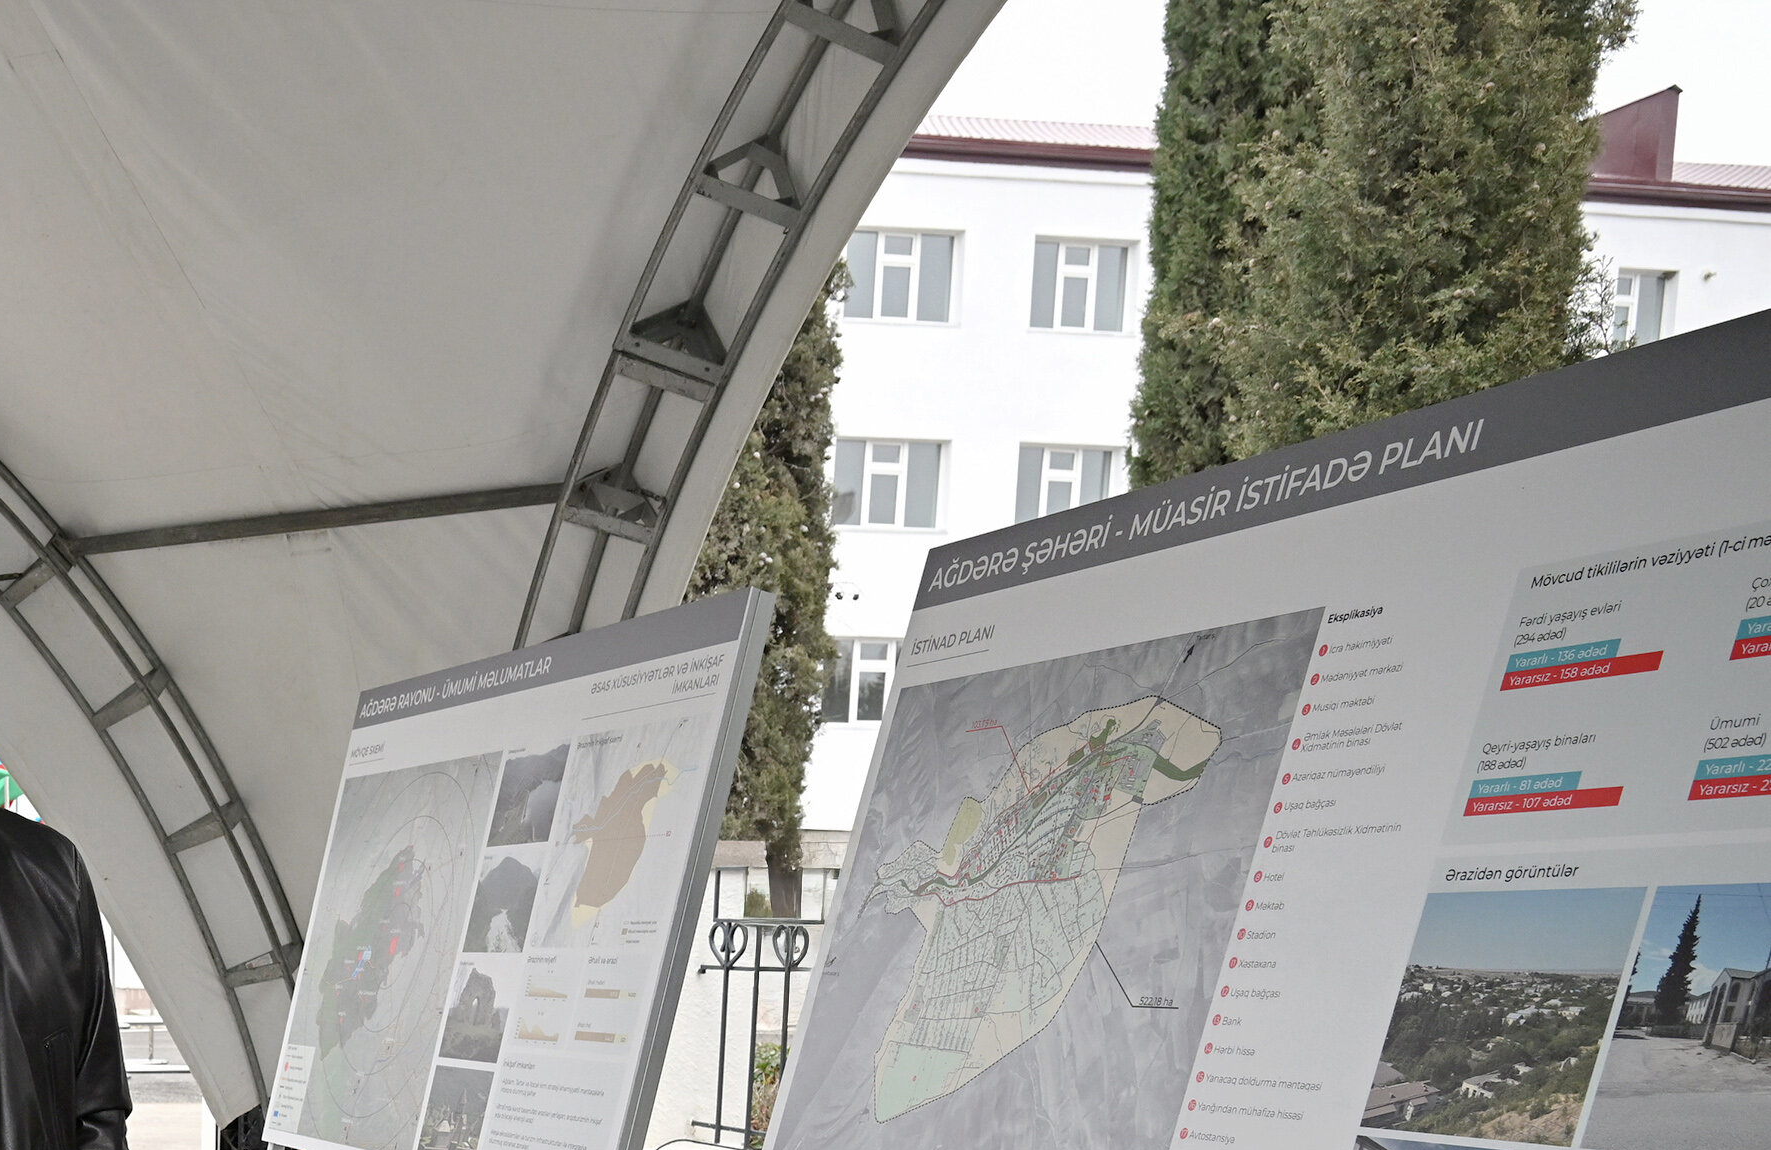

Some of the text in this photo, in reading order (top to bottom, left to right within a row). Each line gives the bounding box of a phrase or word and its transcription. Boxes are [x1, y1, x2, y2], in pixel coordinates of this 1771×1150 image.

[928, 546, 1020, 593] AĞDƏRƏ
[1021, 518, 1111, 576] ŞƏHƏRİ
[1129, 489, 1231, 542] MÜASİR
[1234, 455, 1373, 515] İSTİFADƏ
[1379, 418, 1486, 476] PLANI
[1530, 568, 1584, 590] Mövcud
[1587, 557, 1648, 580] tikililərin
[1651, 542, 1716, 567] vəziyyəti
[1519, 600, 1623, 628] Fərdi yaşayış evləri
[1745, 595, 1766, 614] (20
[1327, 605, 1384, 625] Eksplikasiya
[910, 624, 996, 656] İSTİNAD PLANI
[1513, 627, 1567, 648] (294 ədəd)
[1514, 654, 1548, 669] Yararlı
[1558, 648, 1575, 662] 136
[1577, 644, 1609, 660] ədəd
[1509, 670, 1551, 687] Yararsız
[1559, 666, 1578, 680] 158
[1580, 662, 1611, 677] ədəd
[359, 697, 397, 720] AĞDƏRƏ
[397, 686, 437, 713] RAYONU
[442, 672, 477, 700] ÜMUMİ
[477, 655, 553, 692] MƏLUMATLAR
[671, 674, 720, 696] İMKANLARI
[1710, 713, 1761, 731] Ümumi
[1482, 733, 1597, 757] Qeyri-yaşayış binaları
[1704, 732, 1767, 753] (502 ədəd)
[1477, 756, 1527, 775] (188 ədəd)
[1706, 760, 1746, 776] Yararlı
[1477, 780, 1510, 795] Yararlı
[1519, 778, 1532, 791] 81
[1533, 775, 1563, 790] ədəd
[1700, 783, 1749, 796] Yararsız
[1472, 797, 1513, 813] Yararsız
[1522, 796, 1541, 810] 107
[1542, 793, 1573, 808] ədəd
[1263, 872, 1284, 881] Hotel
[1445, 863, 1579, 884] Ərazidən görüntülər
[1255, 900, 1284, 910] Məktəb
[1246, 929, 1275, 940] Stadion
[1221, 1016, 1241, 1026] Bank
